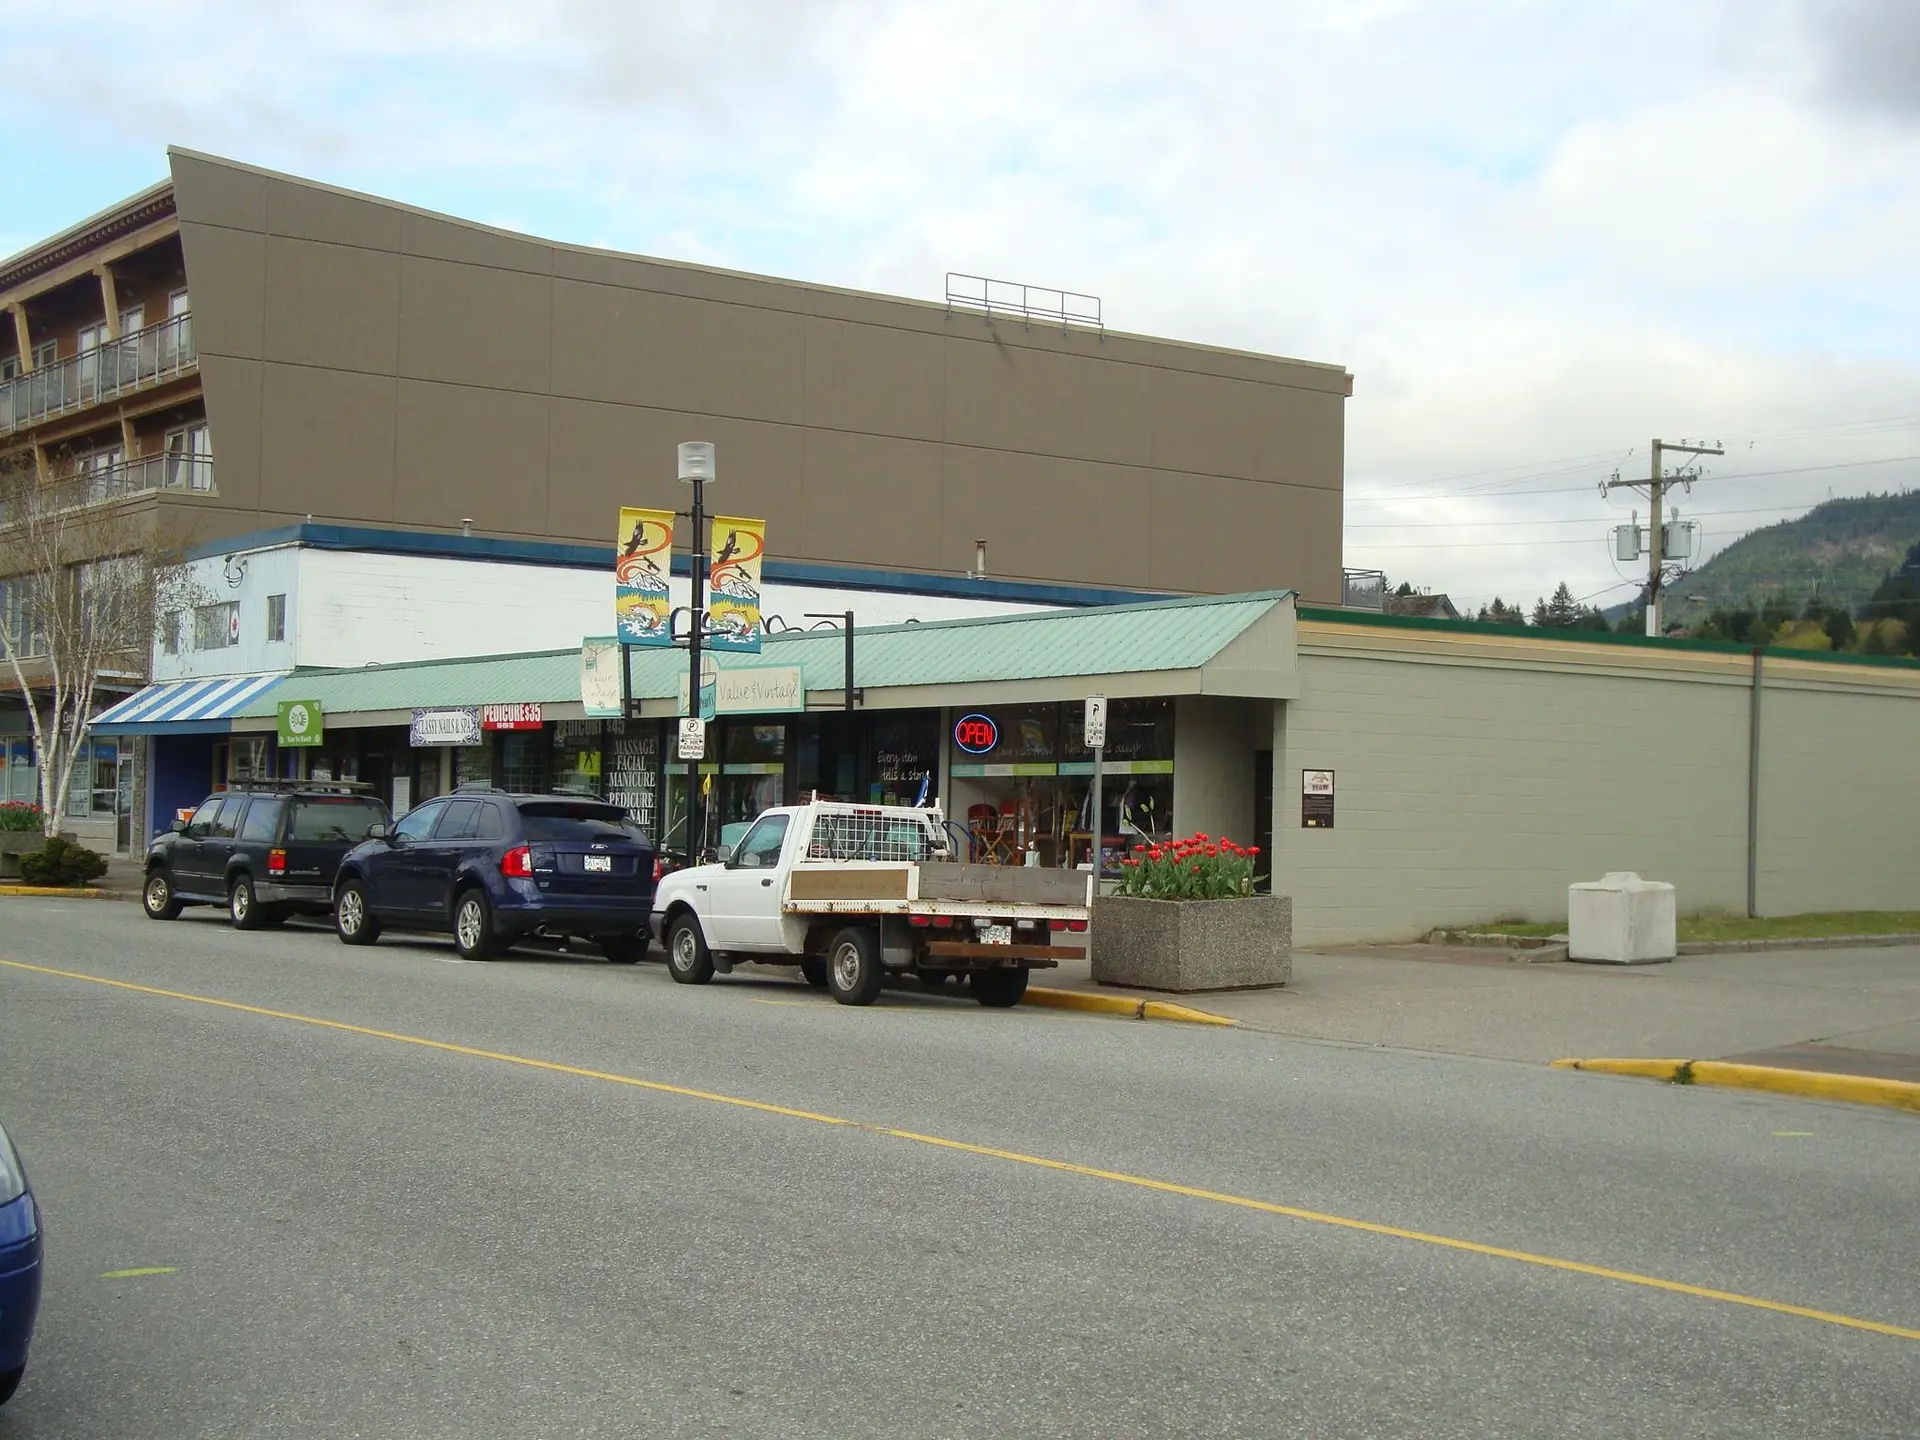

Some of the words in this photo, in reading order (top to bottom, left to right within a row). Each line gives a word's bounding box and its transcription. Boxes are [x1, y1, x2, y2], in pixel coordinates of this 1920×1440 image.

[587, 672, 613, 683] Value
[719, 680, 749, 701] Value
[757, 678, 799, 707] Vintage
[484, 704, 525, 722] PEDICURE
[525, 703, 541, 721] $35
[418, 719, 438, 735] CLASSY
[460, 717, 471, 734] SPA
[956, 723, 993, 745] OPEN
[614, 739, 655, 755] MASSAGE
[617, 755, 646, 771] FACIAL
[878, 750, 900, 770] Every
[902, 751, 918, 763] item
[609, 772, 655, 787] MANICURE
[882, 766, 899, 781] tells
[900, 772, 907, 781] a
[609, 792, 654, 808] PEDICURE
[630, 809, 650, 825] NAIL
